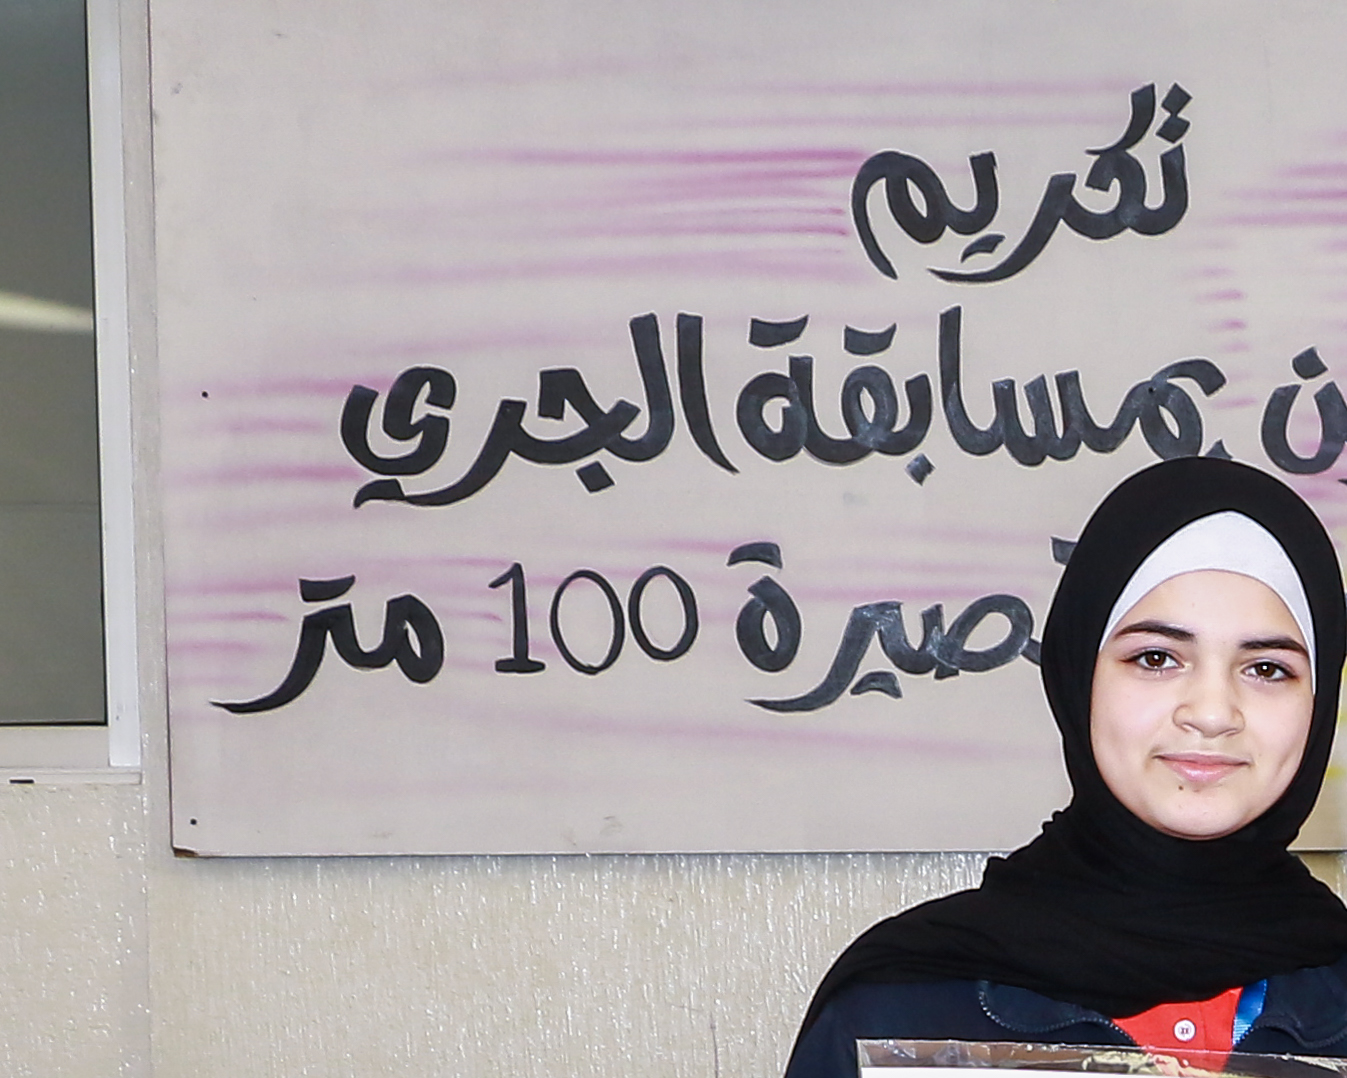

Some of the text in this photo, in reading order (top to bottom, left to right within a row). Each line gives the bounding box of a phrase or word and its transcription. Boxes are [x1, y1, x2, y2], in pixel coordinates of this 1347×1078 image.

[851, 82, 1192, 283] تكريم
[340, 312, 740, 509] الجري
[737, 304, 1227, 488] بمسابقة
[208, 542, 1078, 715] صيرة 100 متر
